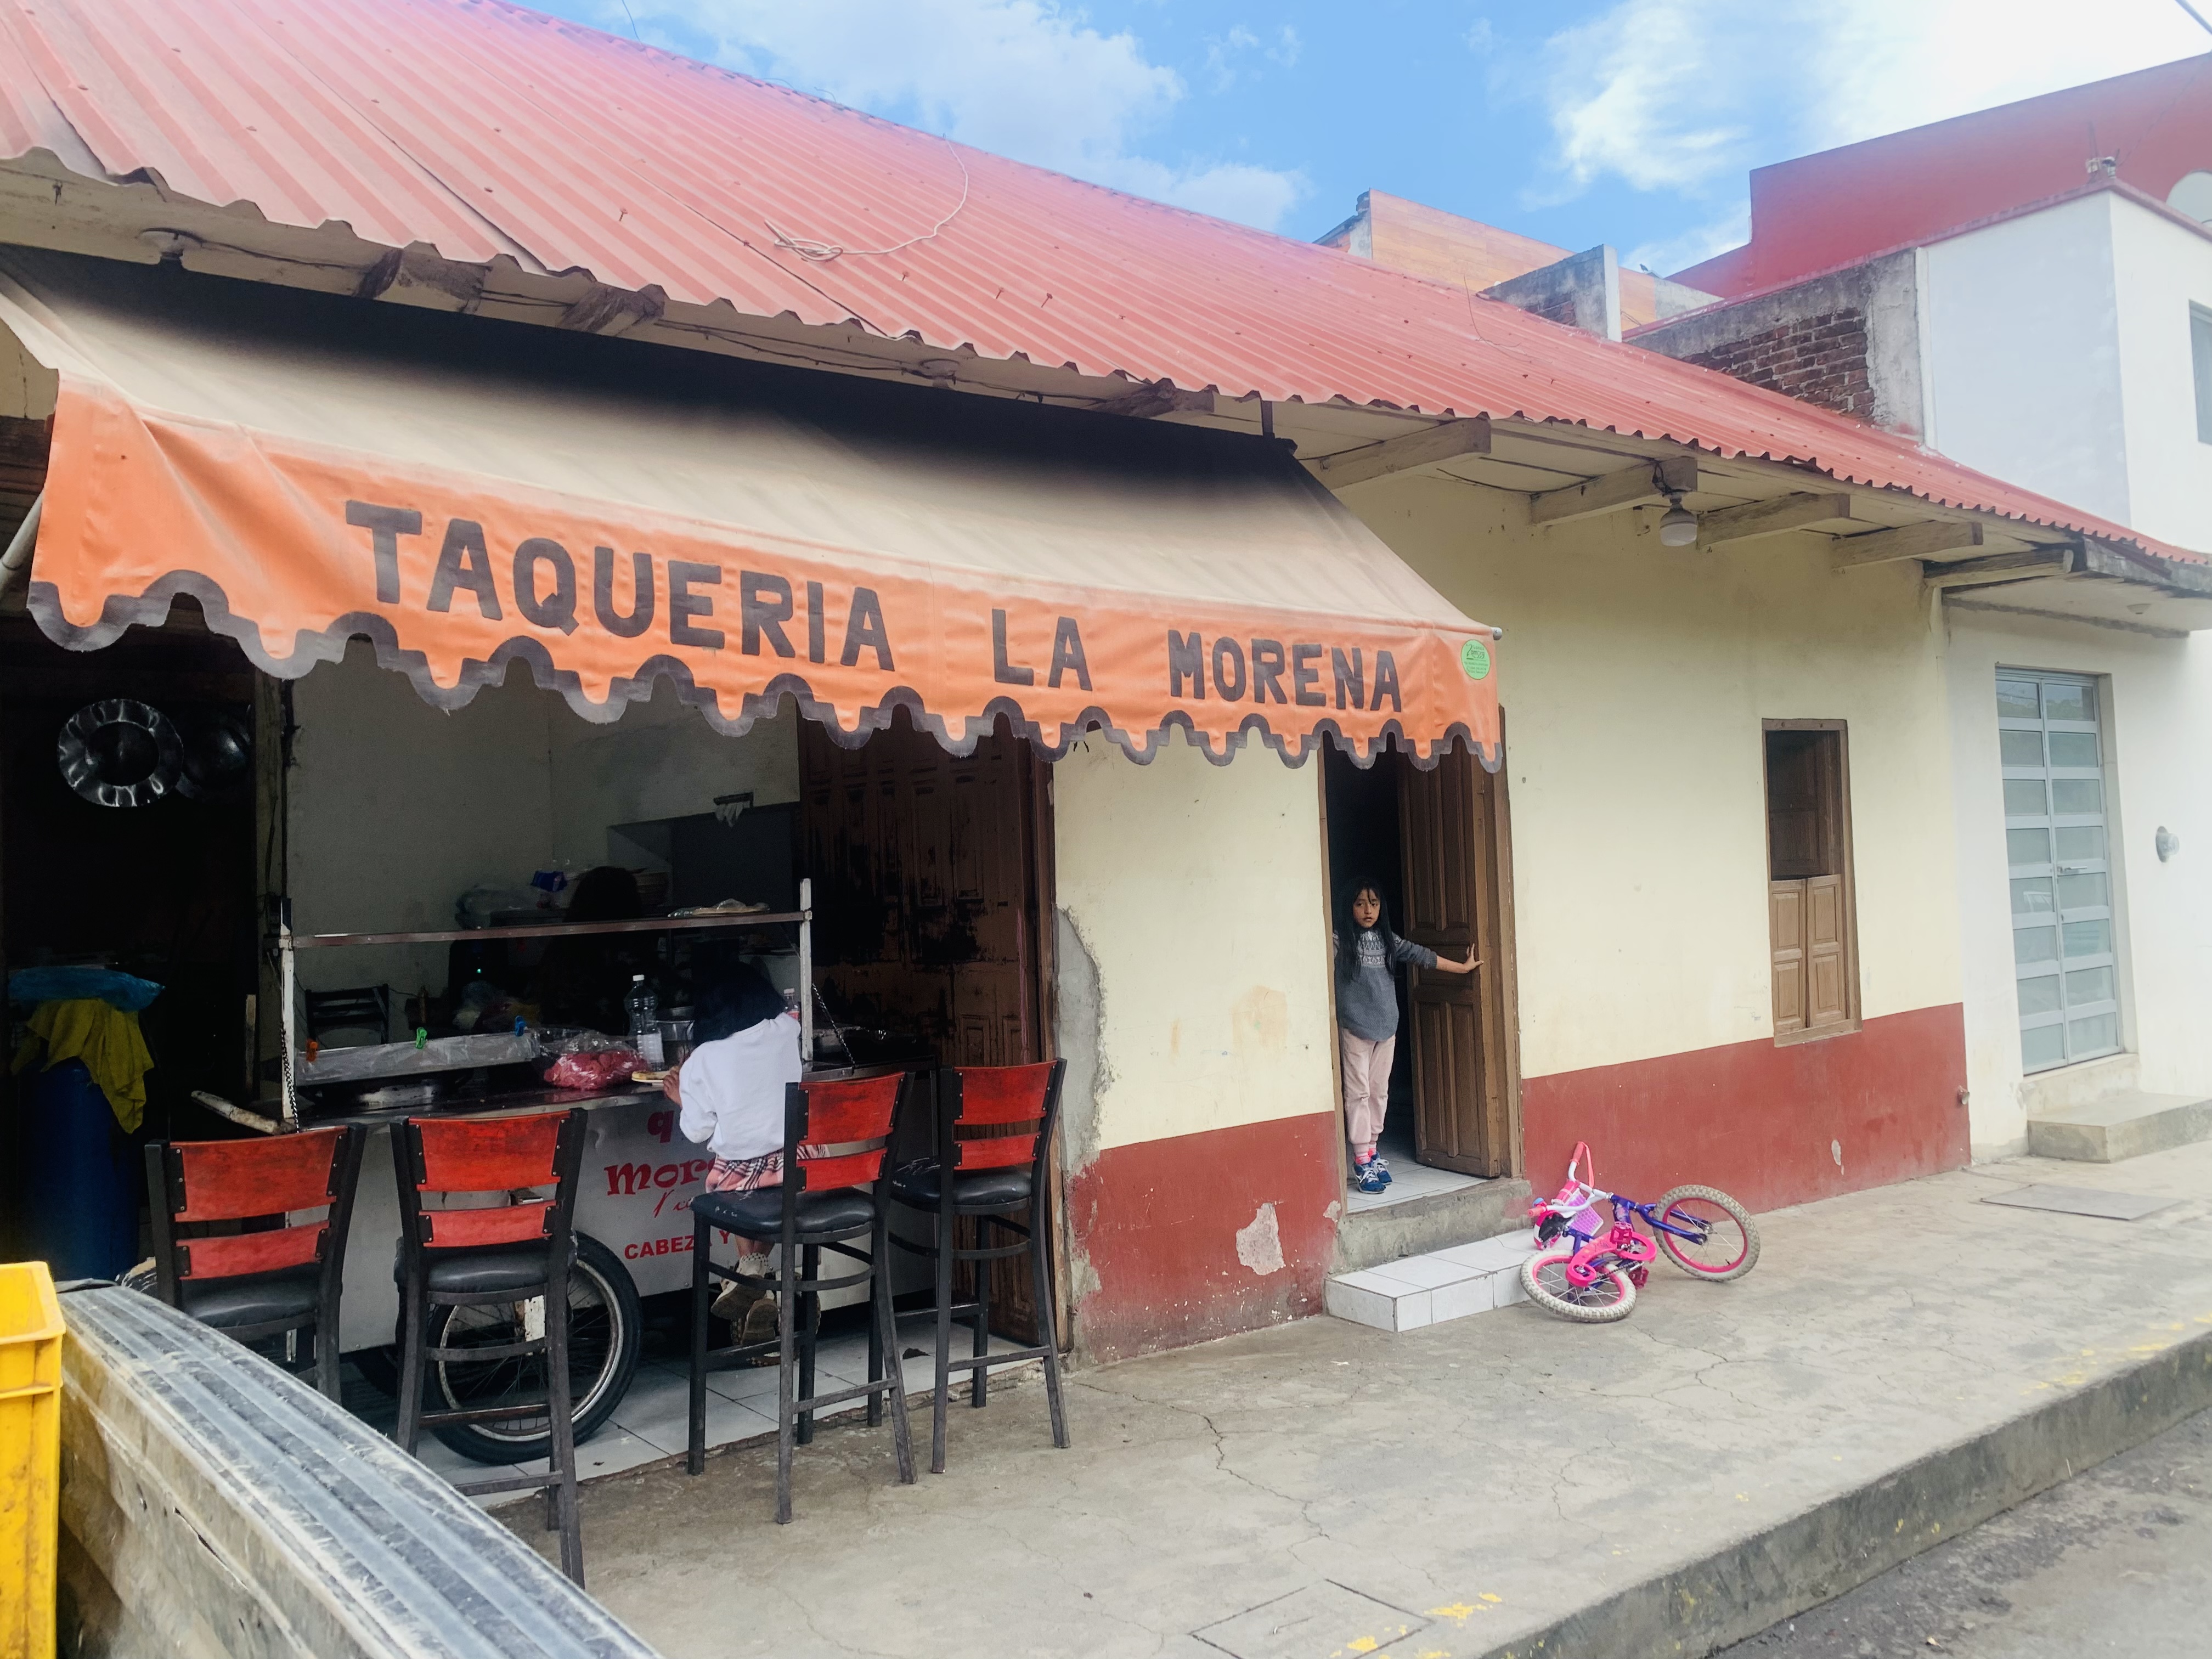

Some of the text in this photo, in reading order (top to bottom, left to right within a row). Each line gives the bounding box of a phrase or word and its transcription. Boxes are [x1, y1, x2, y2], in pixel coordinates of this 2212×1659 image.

[346, 499, 1402, 713] TAQUERIA LA MORENA
[624, 1234, 712, 1260] CABEZ
